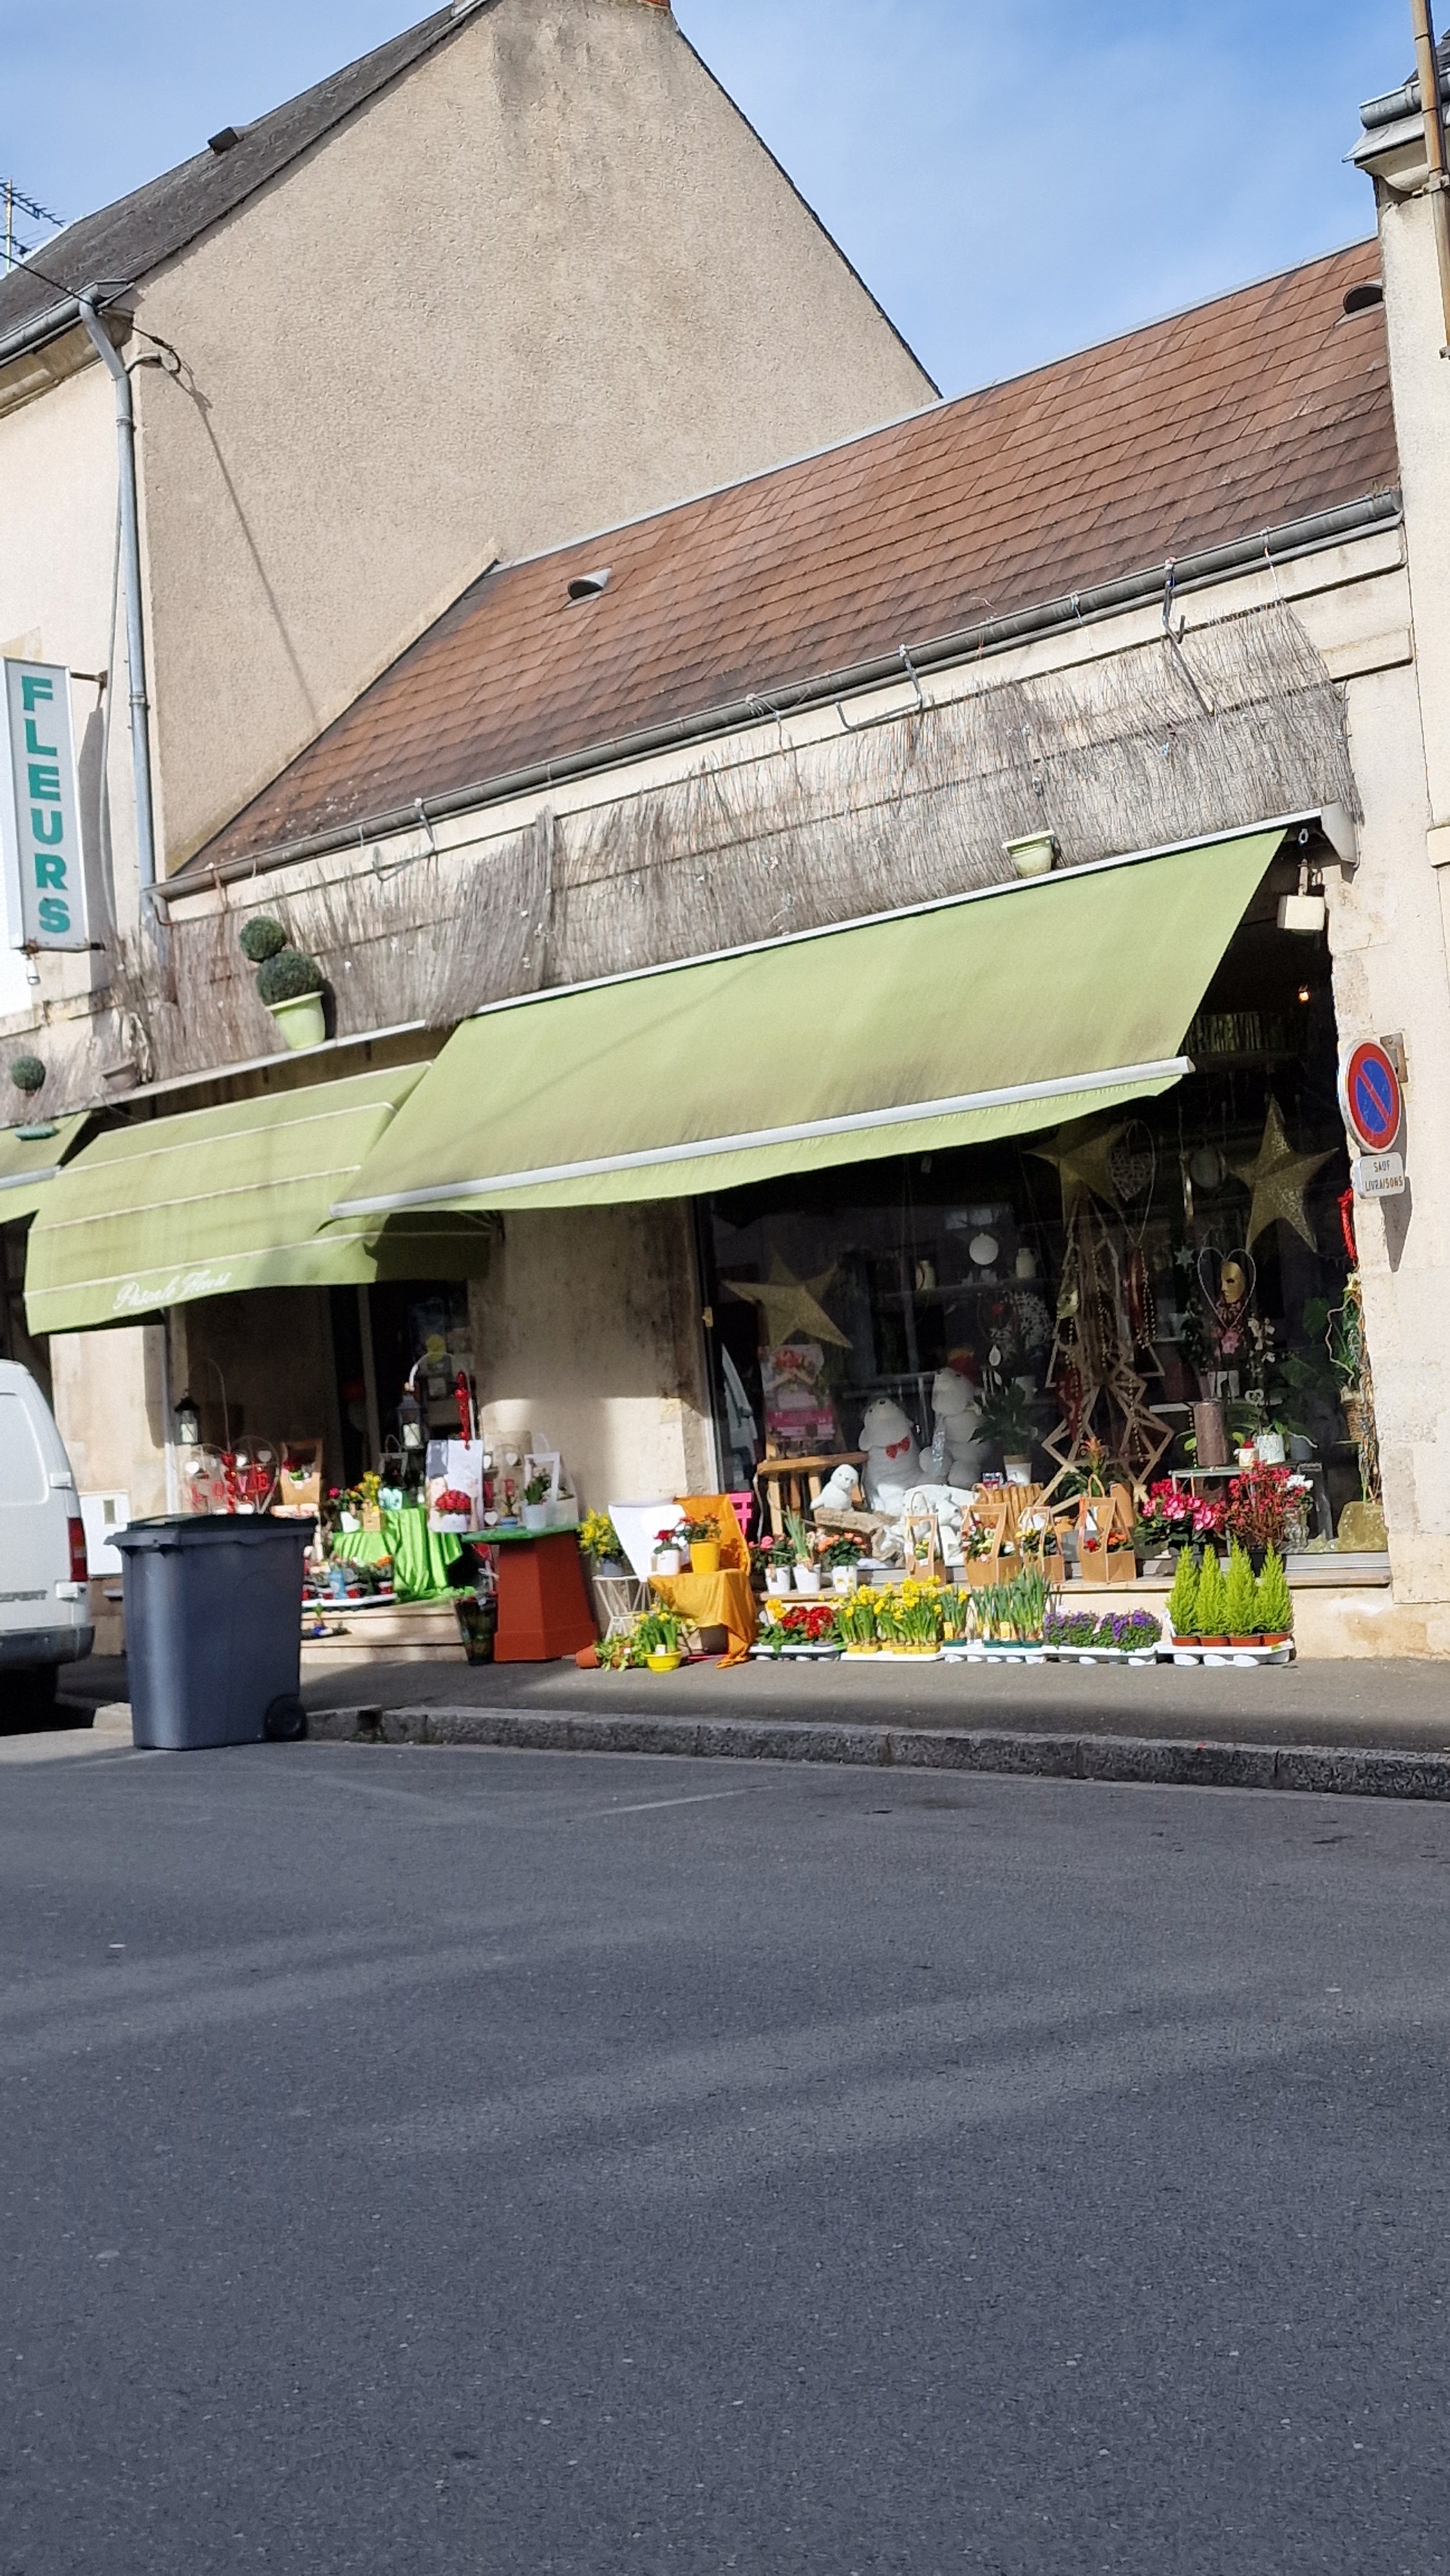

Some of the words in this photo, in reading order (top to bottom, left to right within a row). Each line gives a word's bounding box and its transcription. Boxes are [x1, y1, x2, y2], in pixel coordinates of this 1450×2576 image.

[21, 675, 71, 933] FLEURS
[1373, 1159, 1390, 1173] SAUF
[1365, 1175, 1403, 1191] LIVRAISONS
